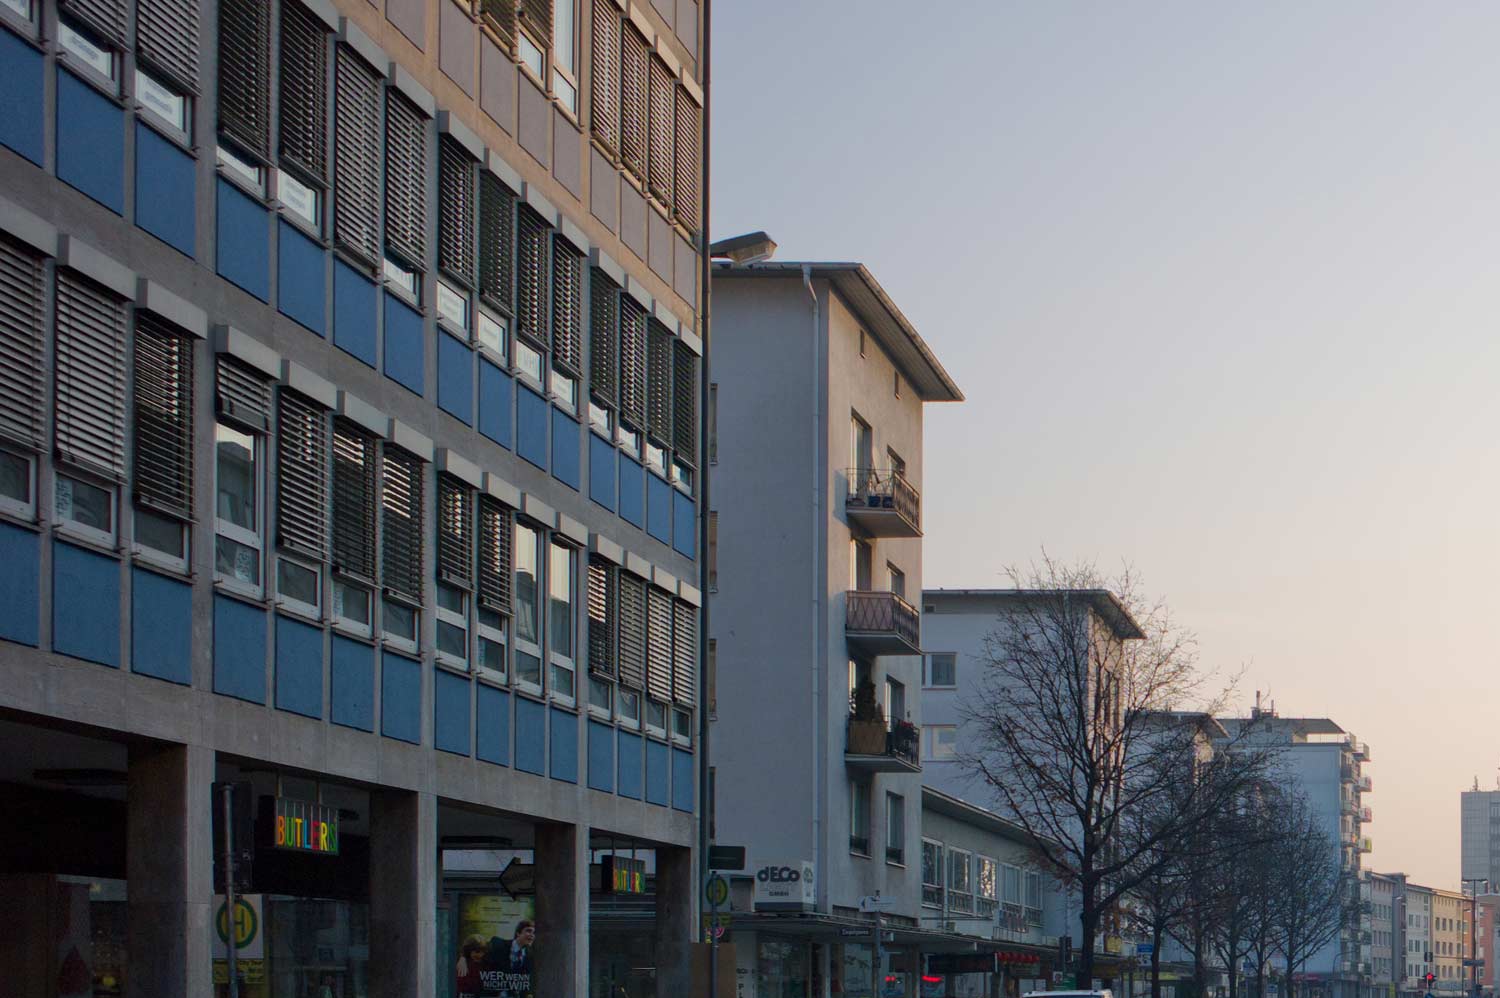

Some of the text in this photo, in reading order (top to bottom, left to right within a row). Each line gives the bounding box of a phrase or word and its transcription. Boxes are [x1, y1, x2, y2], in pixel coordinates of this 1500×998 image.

[277, 815, 338, 852] BUTLERS
[480, 970, 505, 981] WER
[508, 980, 531, 992] WIR
